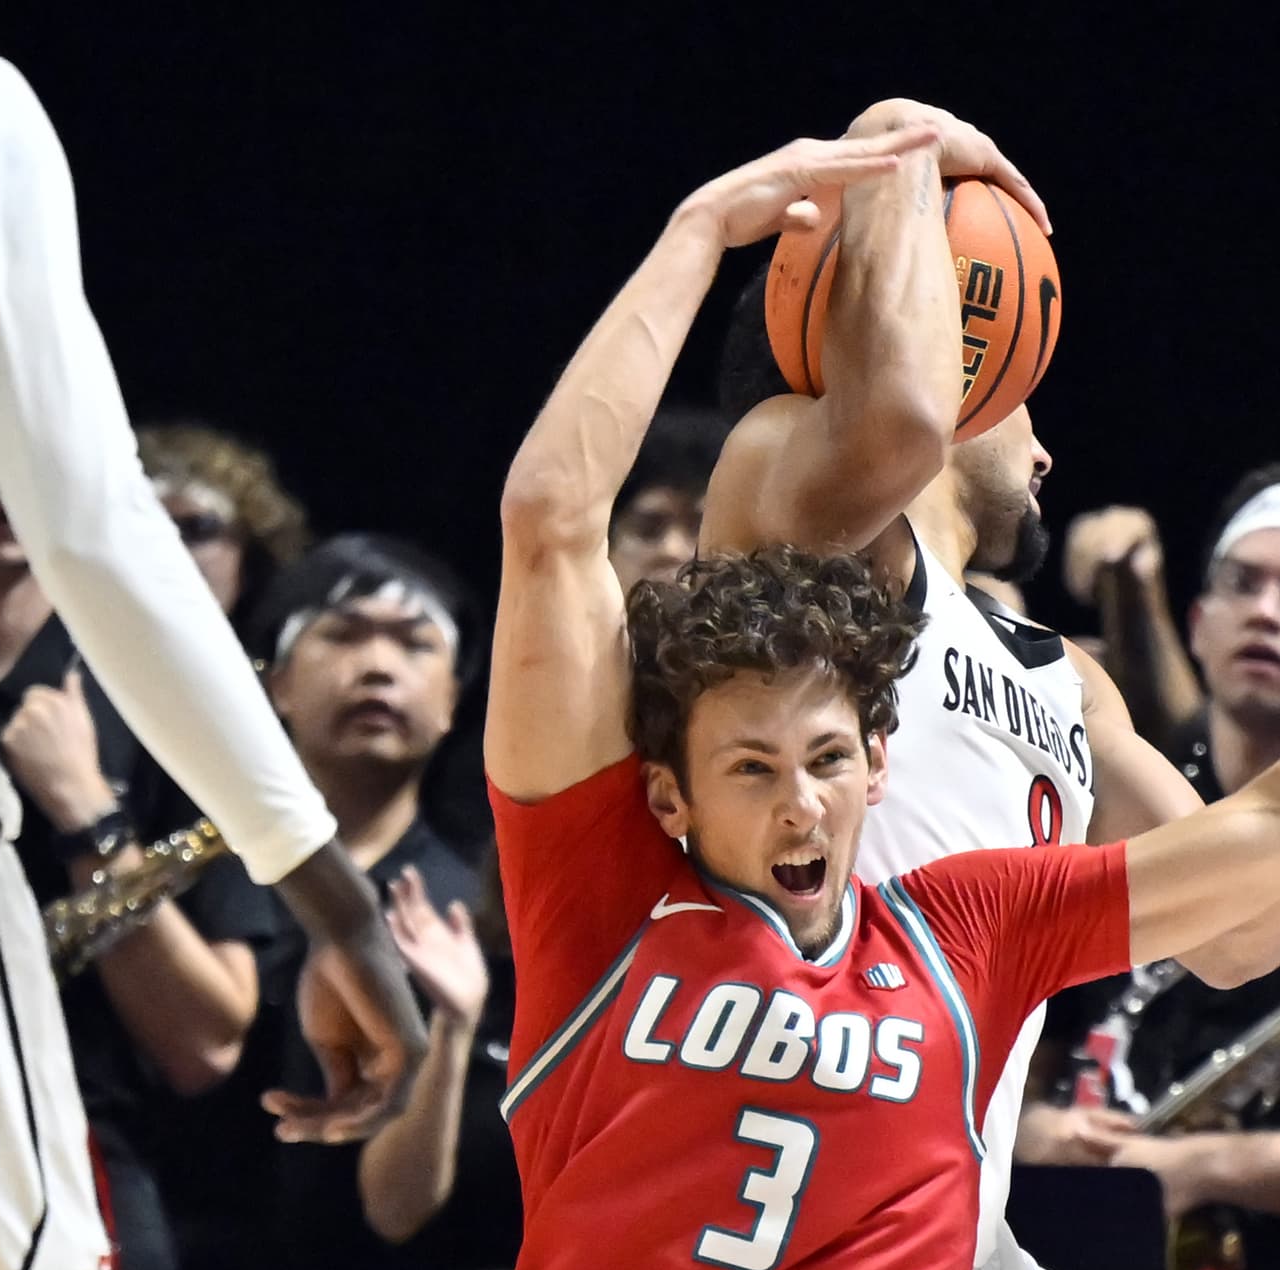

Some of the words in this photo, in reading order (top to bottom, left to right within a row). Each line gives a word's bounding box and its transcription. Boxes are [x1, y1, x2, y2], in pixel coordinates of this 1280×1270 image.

[942, 645, 1000, 727] SAN
[1001, 674, 1072, 775] DIEGO
[622, 974, 926, 1105] LOBOS
